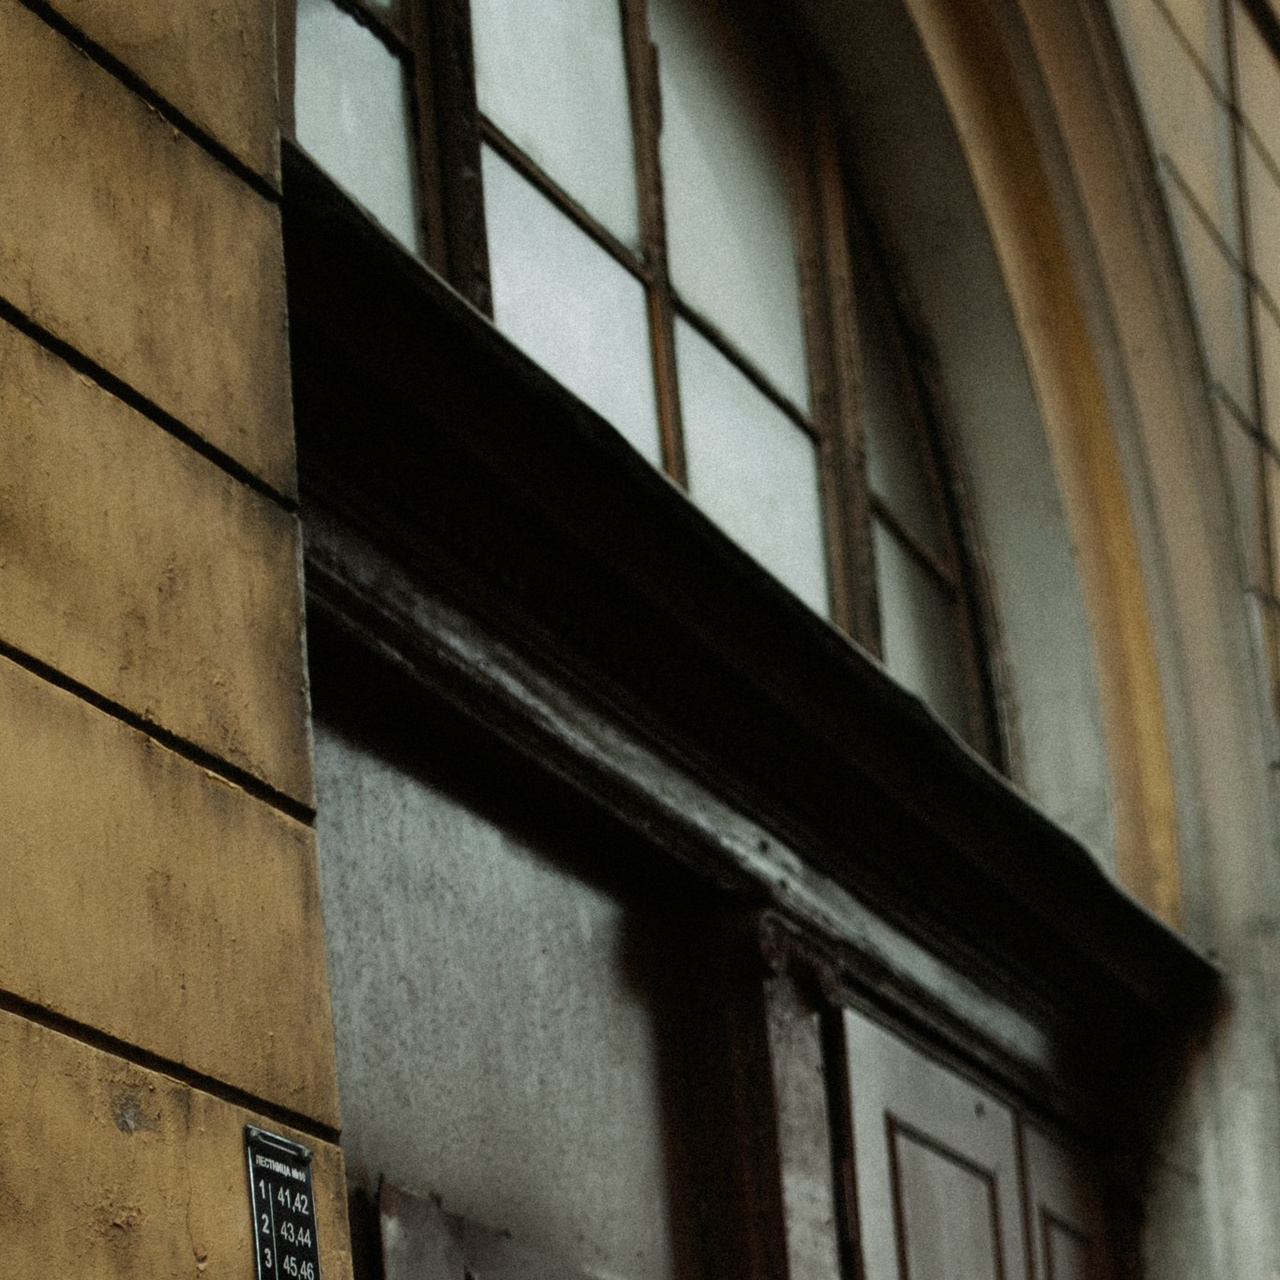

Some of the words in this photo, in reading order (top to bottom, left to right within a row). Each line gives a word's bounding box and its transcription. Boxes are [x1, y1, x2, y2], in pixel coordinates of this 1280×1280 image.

[259, 1179, 266, 1199] 1
[277, 1186, 309, 1215] 41,42
[261, 1213, 270, 1234] 2
[280, 1221, 312, 1248] 43,44
[264, 1248, 272, 1268] 3
